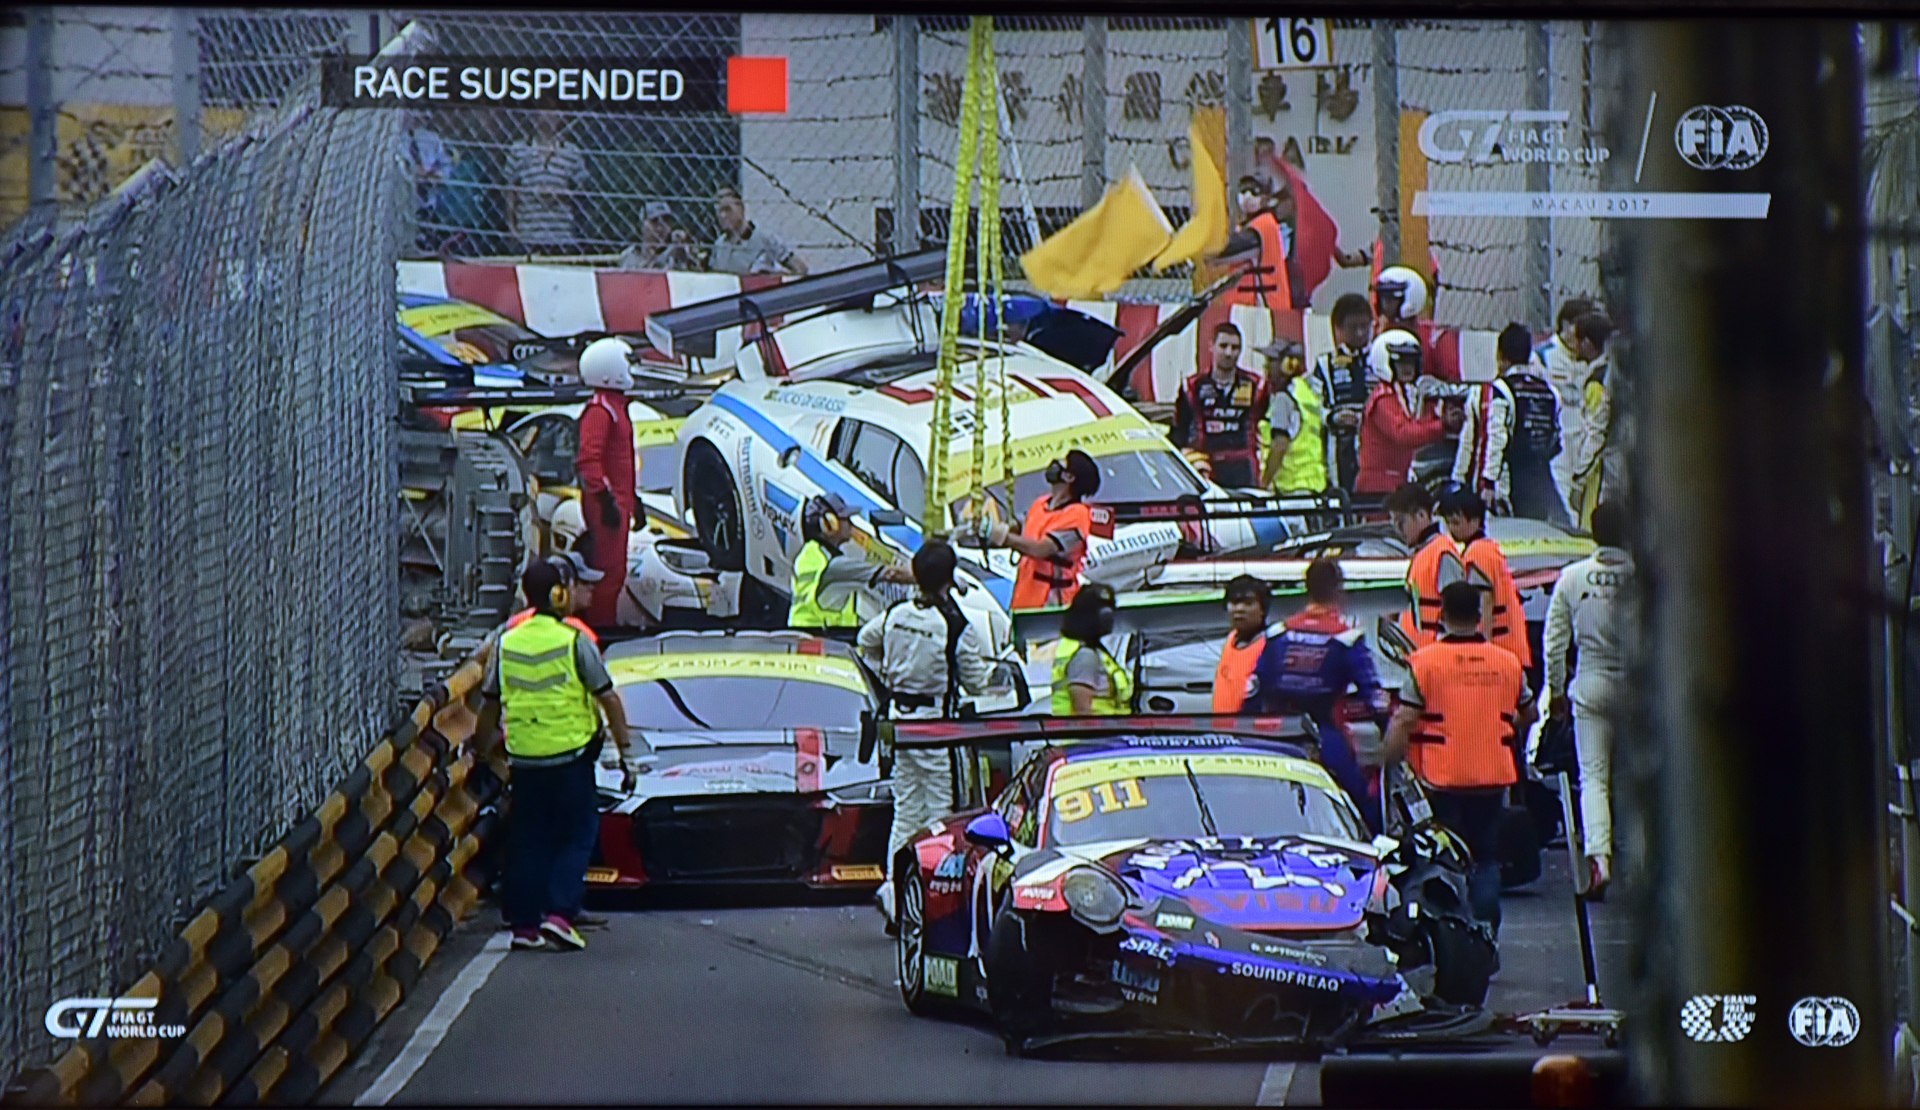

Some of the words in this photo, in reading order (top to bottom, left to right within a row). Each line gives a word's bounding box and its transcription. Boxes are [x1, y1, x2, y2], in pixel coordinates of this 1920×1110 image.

[1266, 18, 1318, 64] 16
[353, 66, 448, 100] RACE
[459, 67, 685, 101] SUSPENDED
[1507, 129, 1537, 143] FIA
[1543, 129, 1566, 143] GT
[1502, 148, 1569, 163] WORLD
[1574, 147, 1610, 164] CUP
[1530, 197, 1597, 212] MACAU
[1607, 199, 1651, 212] 2017
[1056, 777, 1148, 823] 911
[1231, 962, 1340, 992] SOUNDFREAQ
[111, 1010, 135, 1024] FIA
[136, 1010, 155, 1024] GT
[1794, 1007, 1853, 1036] FIA
[106, 1025, 157, 1038] WORLD
[158, 1025, 186, 1038] CUP
